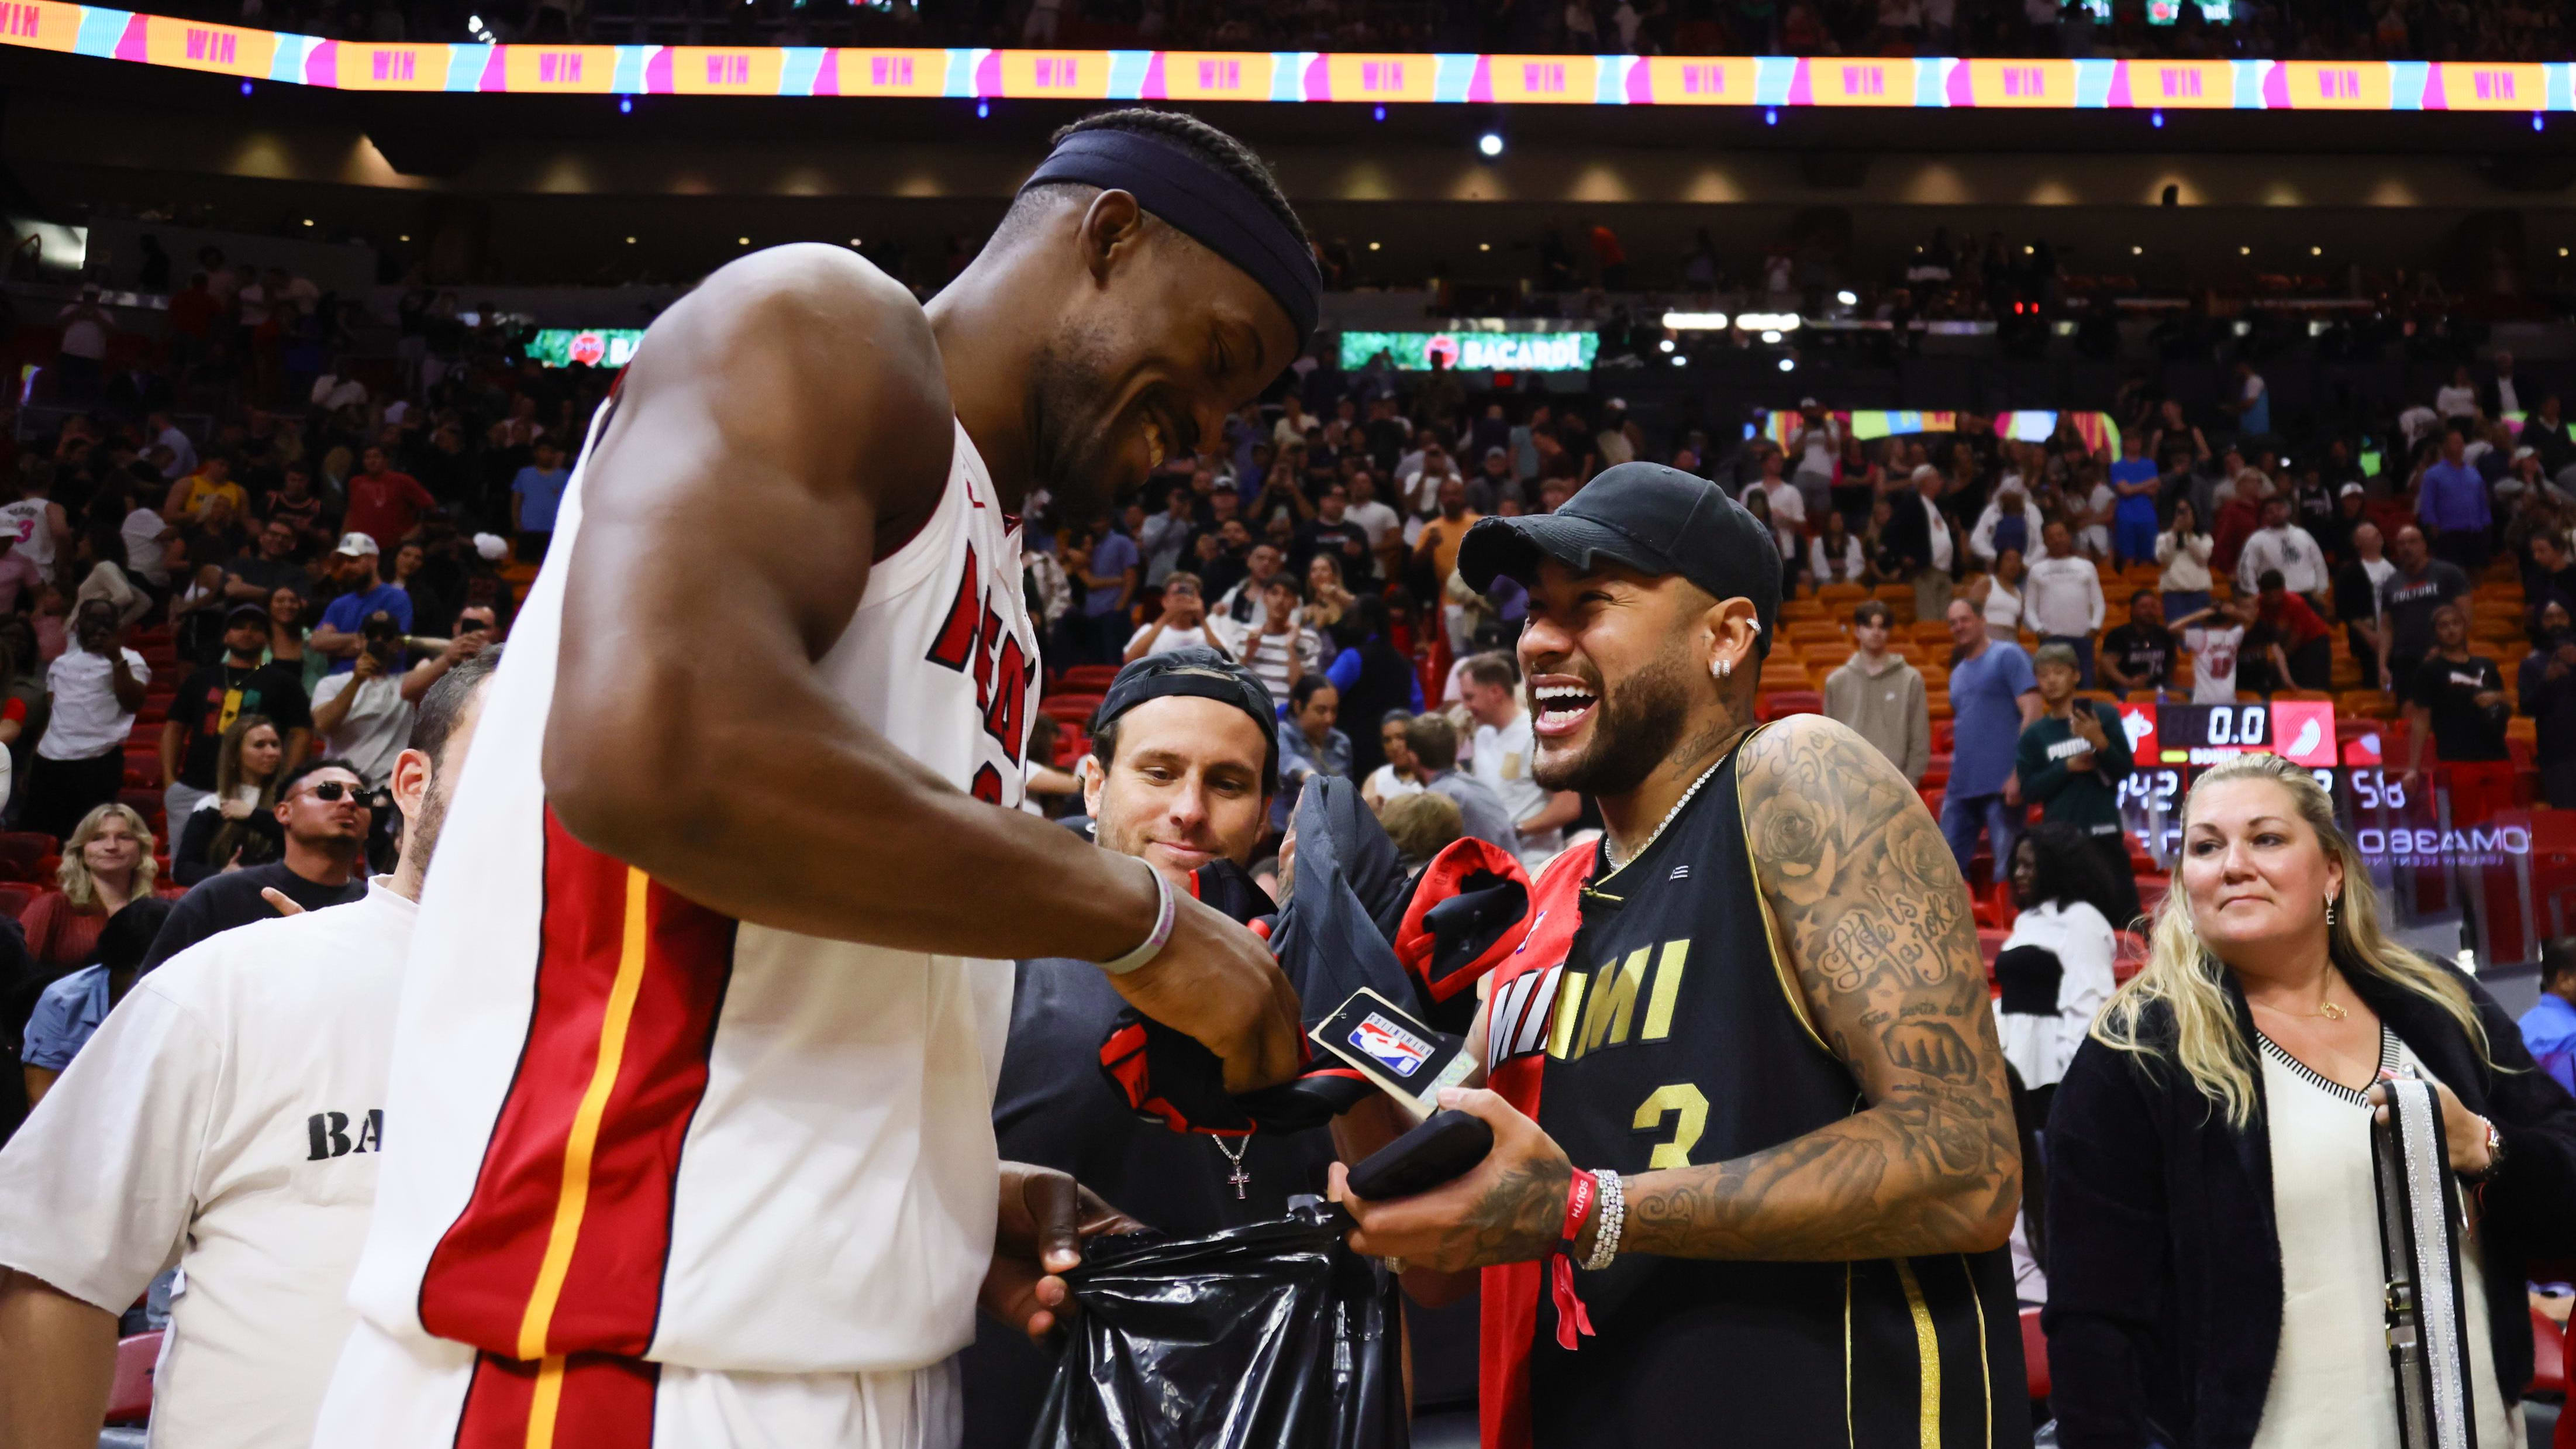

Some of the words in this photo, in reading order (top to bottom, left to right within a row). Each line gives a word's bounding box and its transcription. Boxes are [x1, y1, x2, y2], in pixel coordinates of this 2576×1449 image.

[187, 28, 238, 64] WIN
[373, 51, 416, 81] WIN
[540, 54, 583, 82] WIN
[707, 56, 749, 84] WIN
[872, 57, 913, 85] WIN
[1036, 60, 1077, 87] WIN
[1199, 62, 1240, 88] WIN
[1363, 63, 1403, 90] WIN
[1525, 64, 1564, 91] WIN
[1684, 67, 1723, 93] WIN
[1843, 68, 1884, 94] WIN
[2003, 69, 2044, 95] WIN
[2161, 70, 2202, 96] WIN
[2319, 71, 2360, 98] WIN
[2474, 73, 2515, 99] WIN
[2208, 706, 2266, 745] 0.0
[1487, 938, 1691, 1078] MIAMI
[306, 1109, 384, 1161] BA
[1632, 1082, 1710, 1169] 3
[1571, 1179, 1589, 1219] SOUTH
